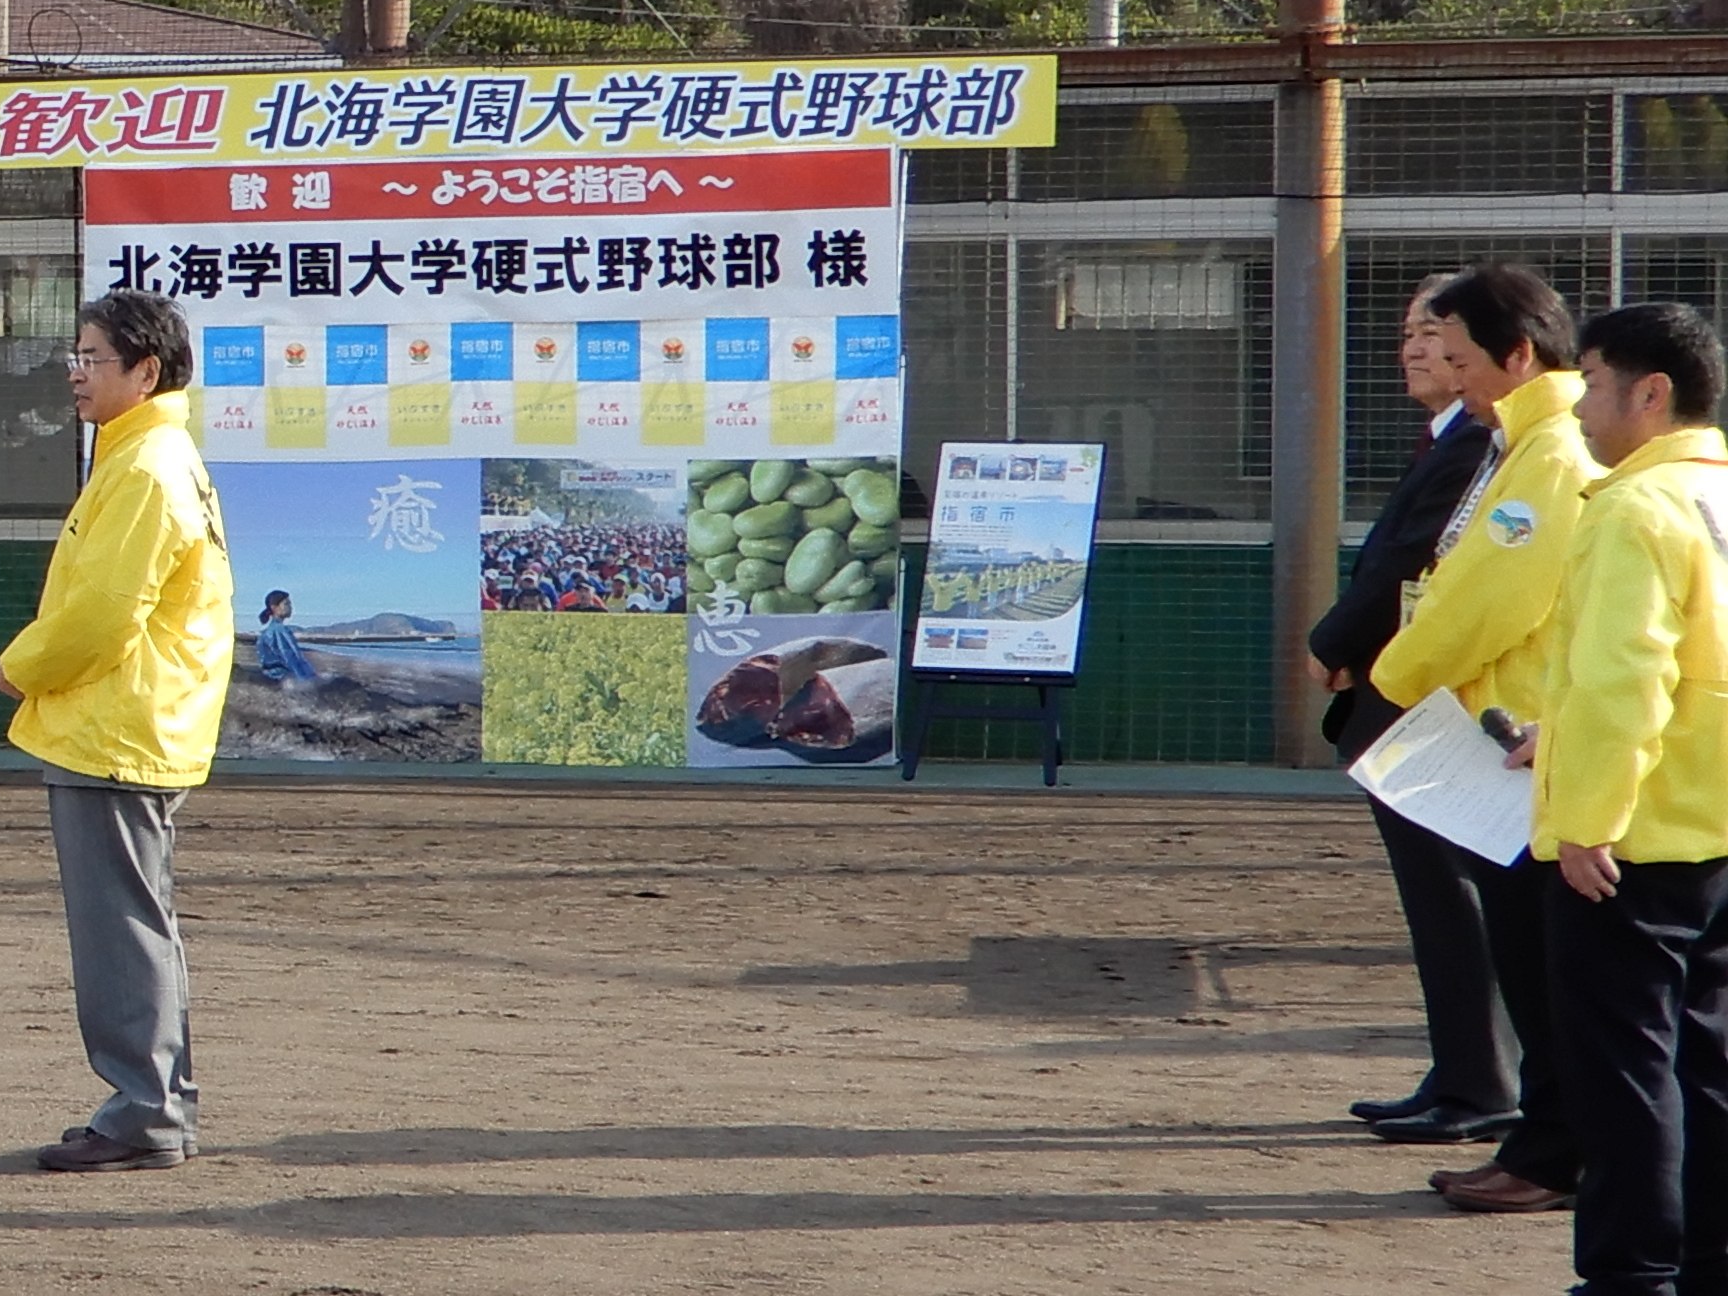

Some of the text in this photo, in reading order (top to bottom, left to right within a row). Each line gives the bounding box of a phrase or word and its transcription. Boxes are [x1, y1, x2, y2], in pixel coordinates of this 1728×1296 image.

[250, 67, 1024, 149] 北海学園大学硬式野球部
[109, 229, 869, 298] 北海学園大学硬式野球部 様
[367, 473, 445, 553] 癒
[693, 581, 760, 658] 恵
